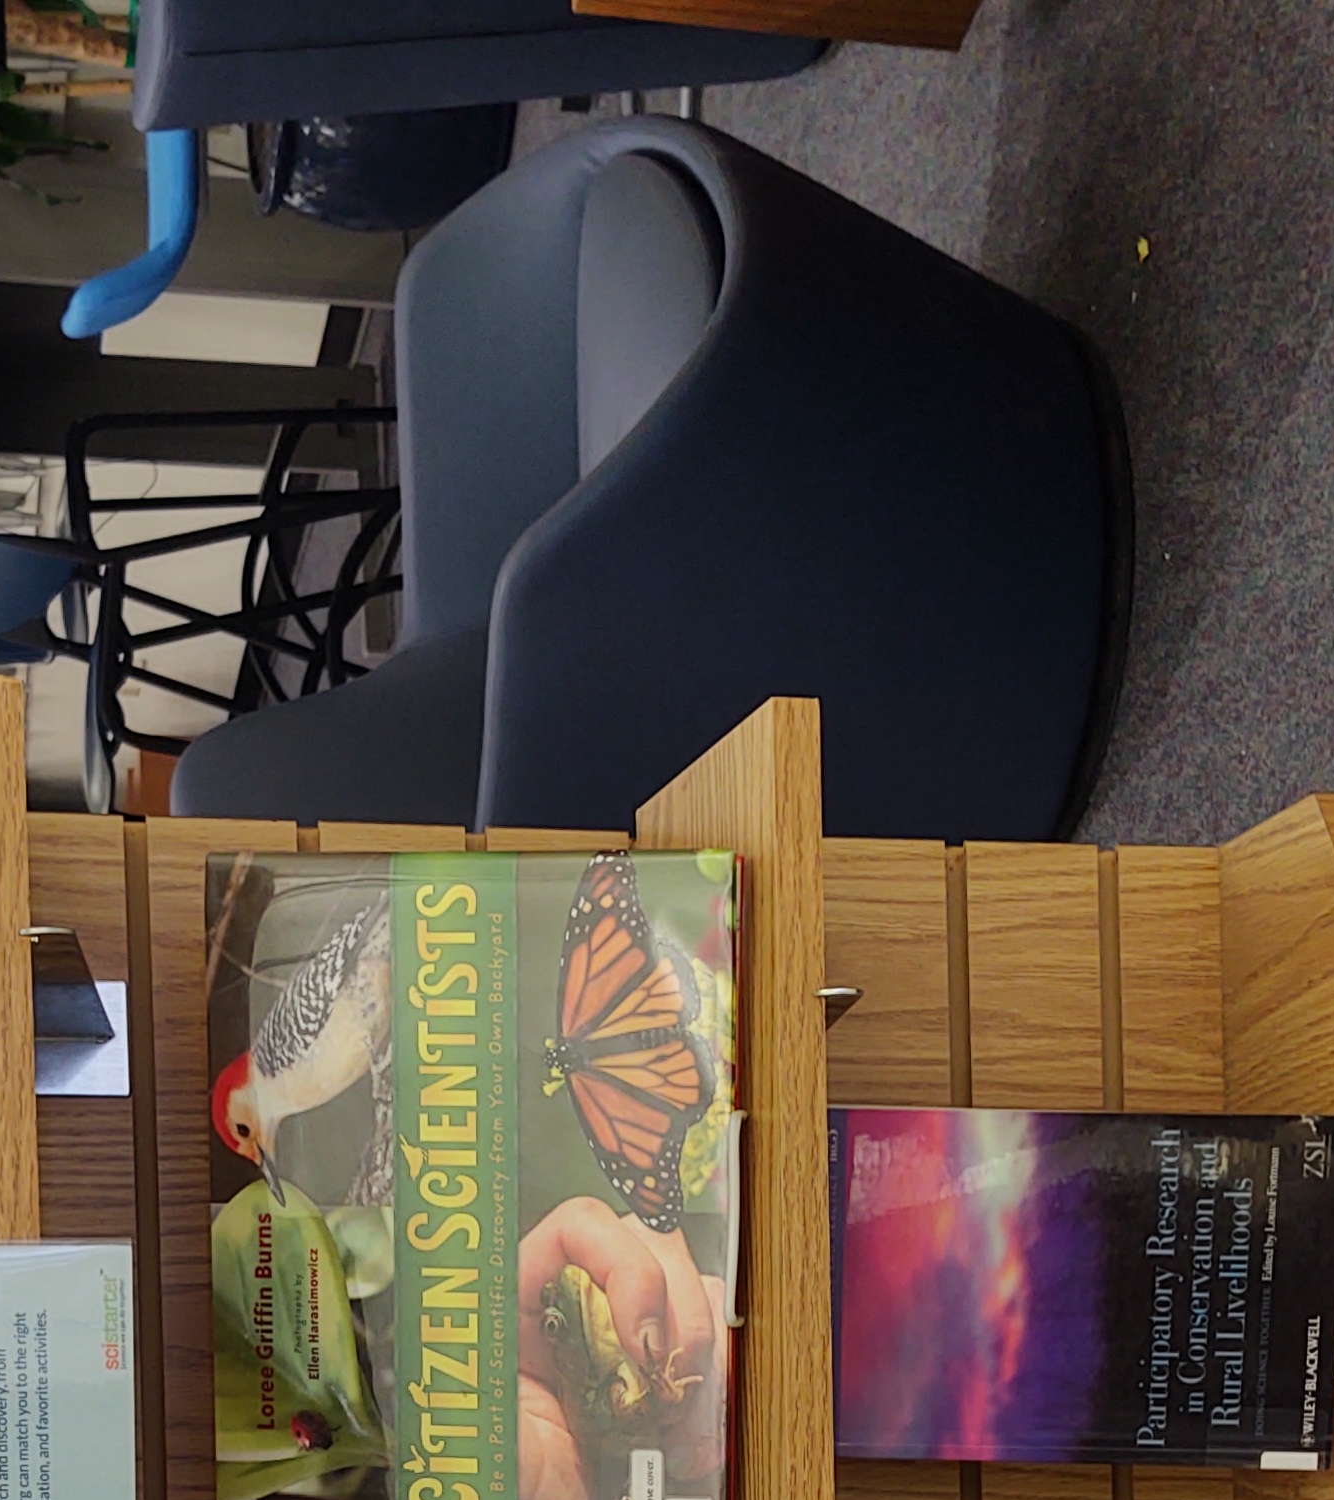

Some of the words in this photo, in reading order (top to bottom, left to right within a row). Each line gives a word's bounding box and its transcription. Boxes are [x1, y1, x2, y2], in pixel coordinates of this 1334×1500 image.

[1145, 1129, 1181, 1257] Research
[1194, 1143, 1220, 1189] and
[1303, 1134, 1326, 1179] ZSL
[253, 1212, 274, 1280] Burns
[1216, 1177, 1254, 1340] Livelihoods
[253, 1286, 275, 1359] Griffin
[305, 1248, 320, 1344] Harasimowicz
[1177, 1199, 1215, 1385] Conservation
[307, 1347, 321, 1381] Ellen
[1136, 1266, 1184, 1446] Participatory
[1211, 1350, 1245, 1427] Rural
[1302, 1315, 1321, 1433] WILEY-BLACKWELL
[254, 1365, 276, 1430] Loree
[1181, 1391, 1205, 1414] in
